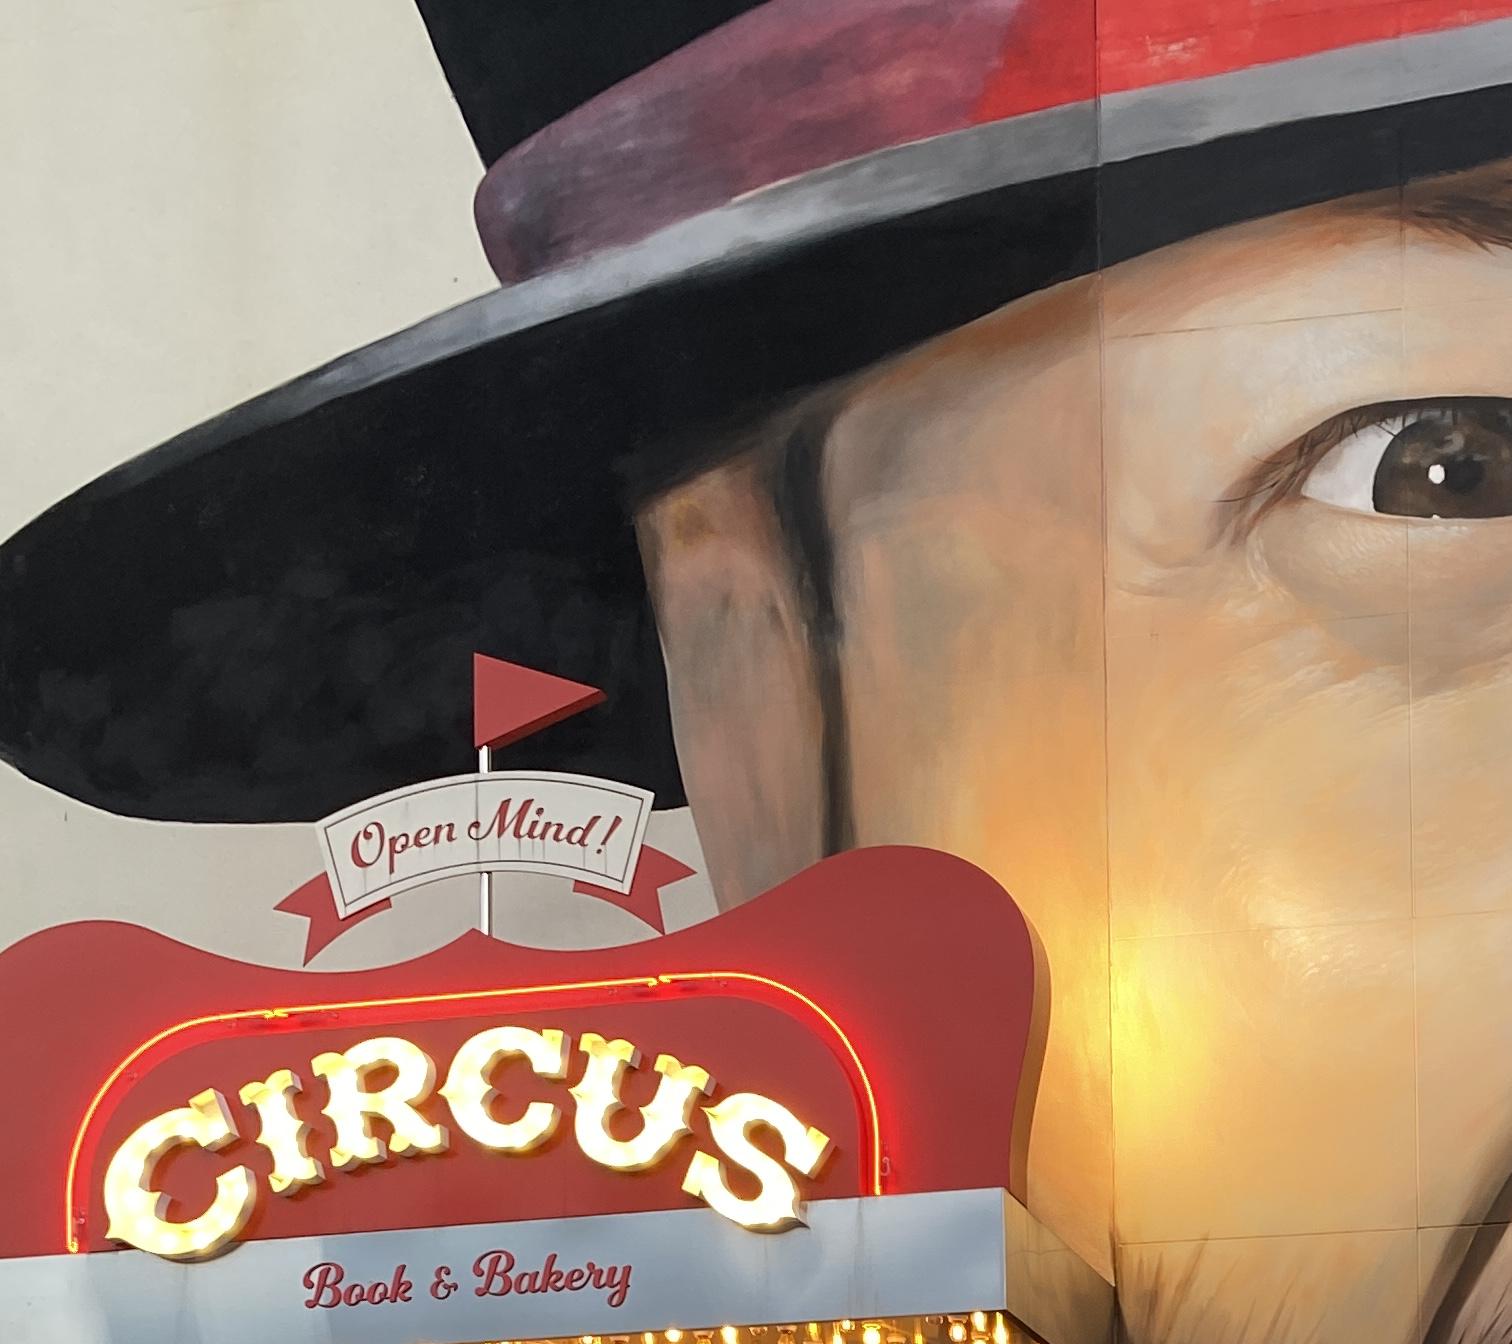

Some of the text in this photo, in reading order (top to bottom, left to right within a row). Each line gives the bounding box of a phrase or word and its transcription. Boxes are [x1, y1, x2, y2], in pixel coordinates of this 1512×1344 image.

[352, 798, 622, 875] Open Mind!
[104, 1026, 836, 1258] CIRCUS
[303, 1248, 632, 1309] Book & Bakery
